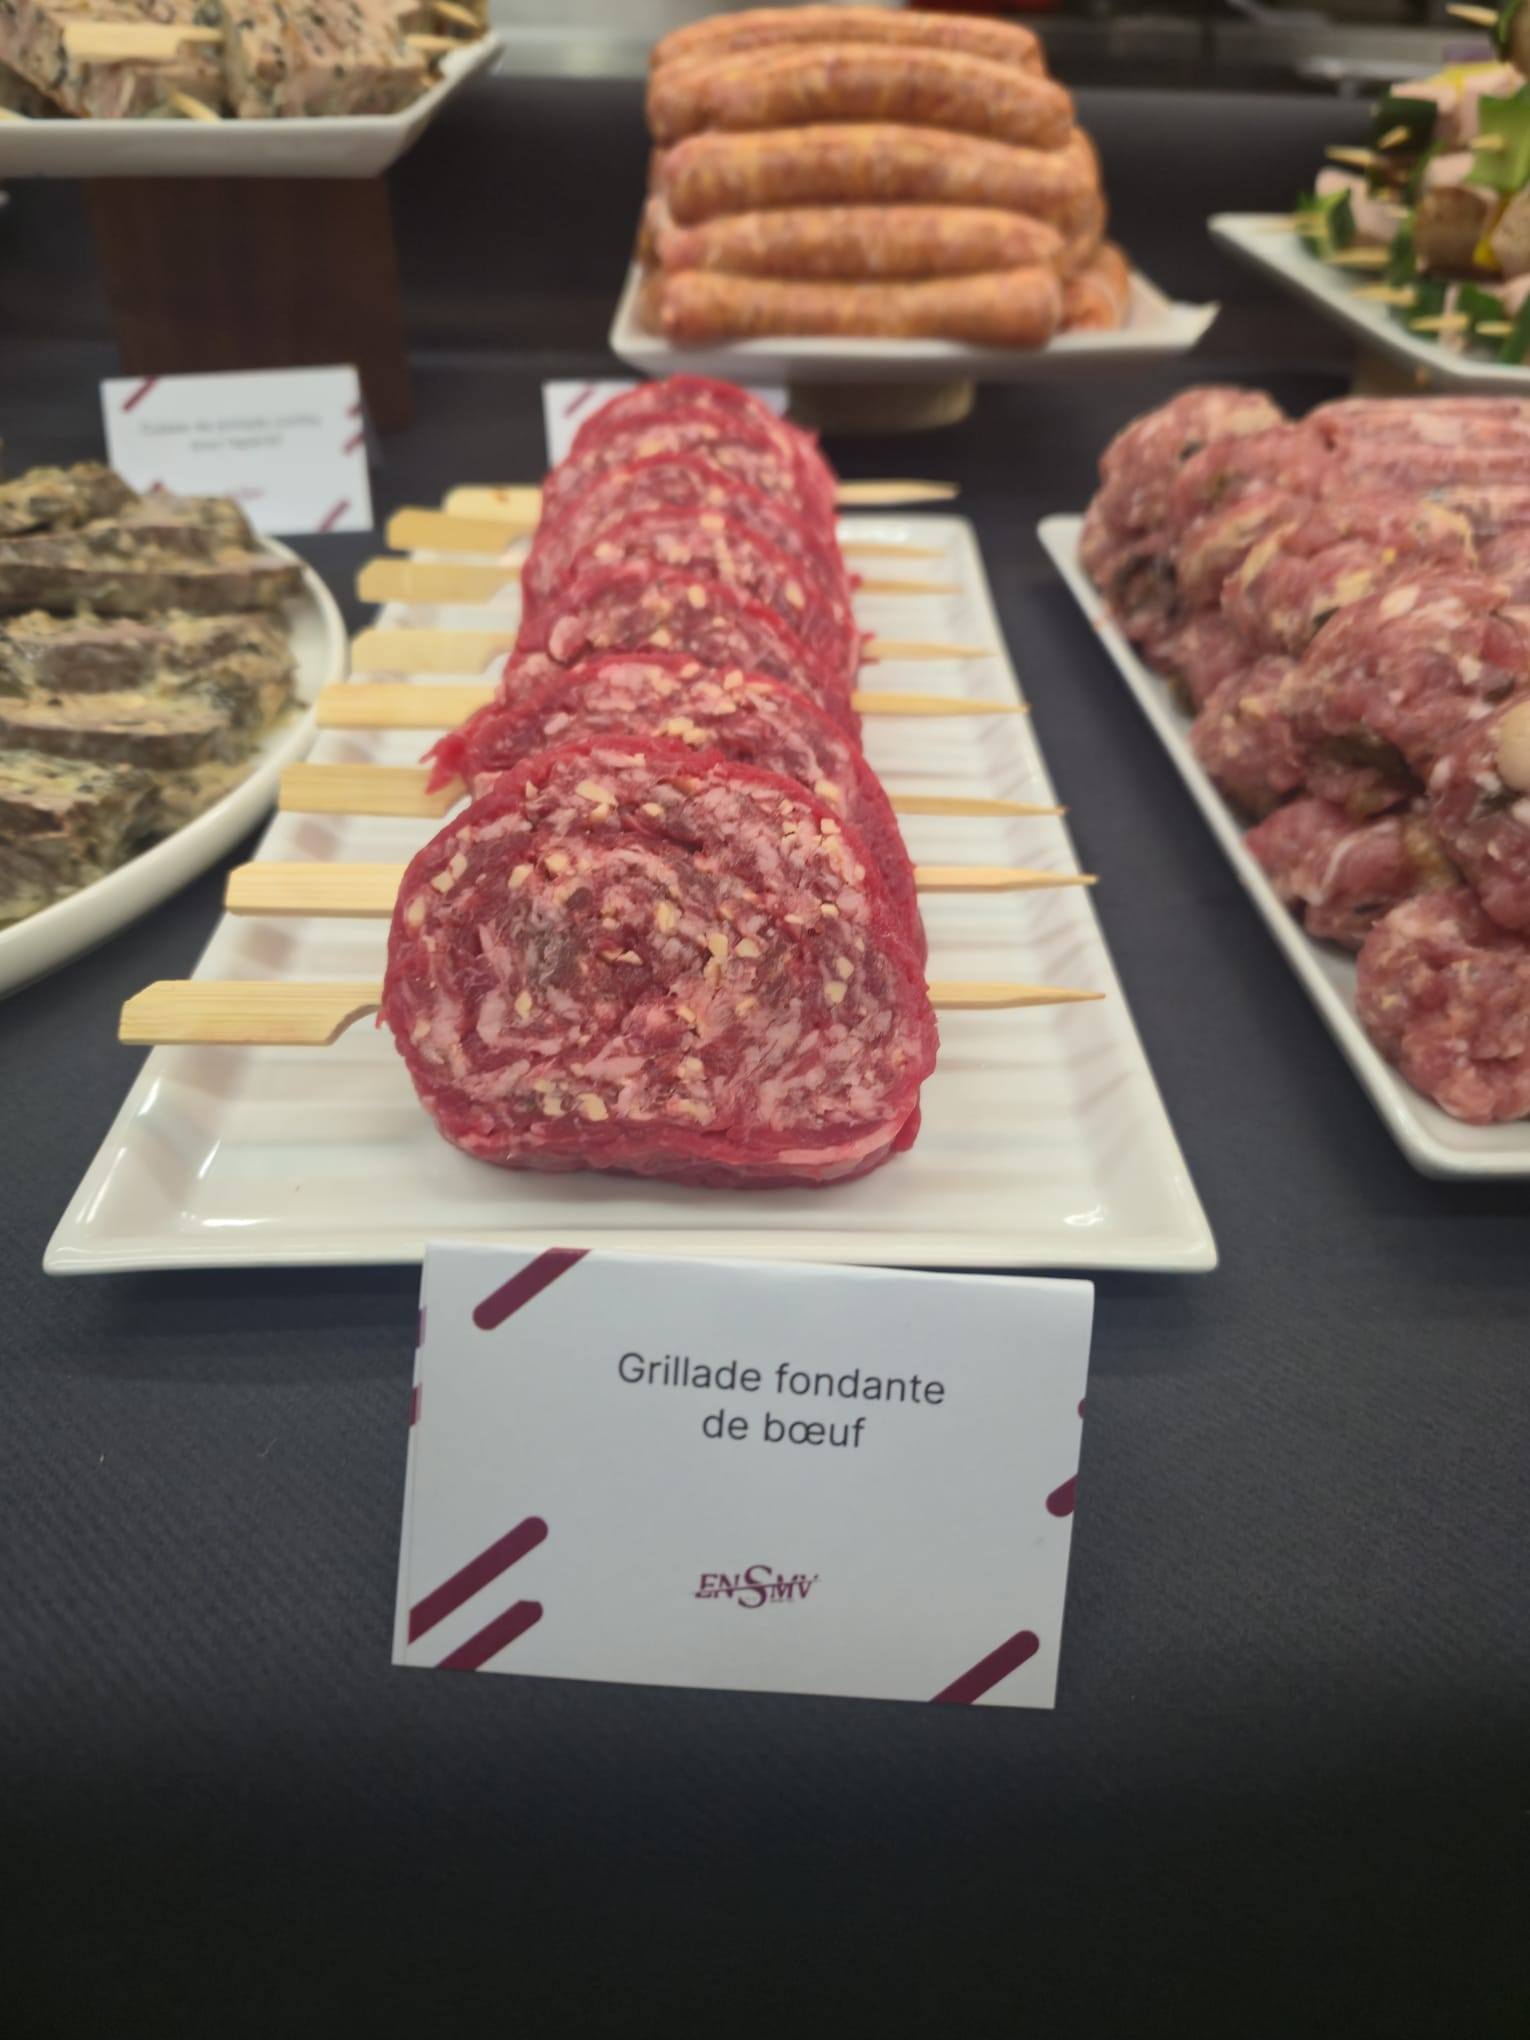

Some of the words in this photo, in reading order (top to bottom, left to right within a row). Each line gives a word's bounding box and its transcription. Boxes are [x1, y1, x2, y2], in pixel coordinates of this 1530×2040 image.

[618, 1352, 761, 1391] Grillade
[775, 1362, 945, 1405] fondante
[702, 1409, 749, 1440] de
[763, 1412, 866, 1448] bœuf
[693, 1565, 819, 1608] ENSMV
